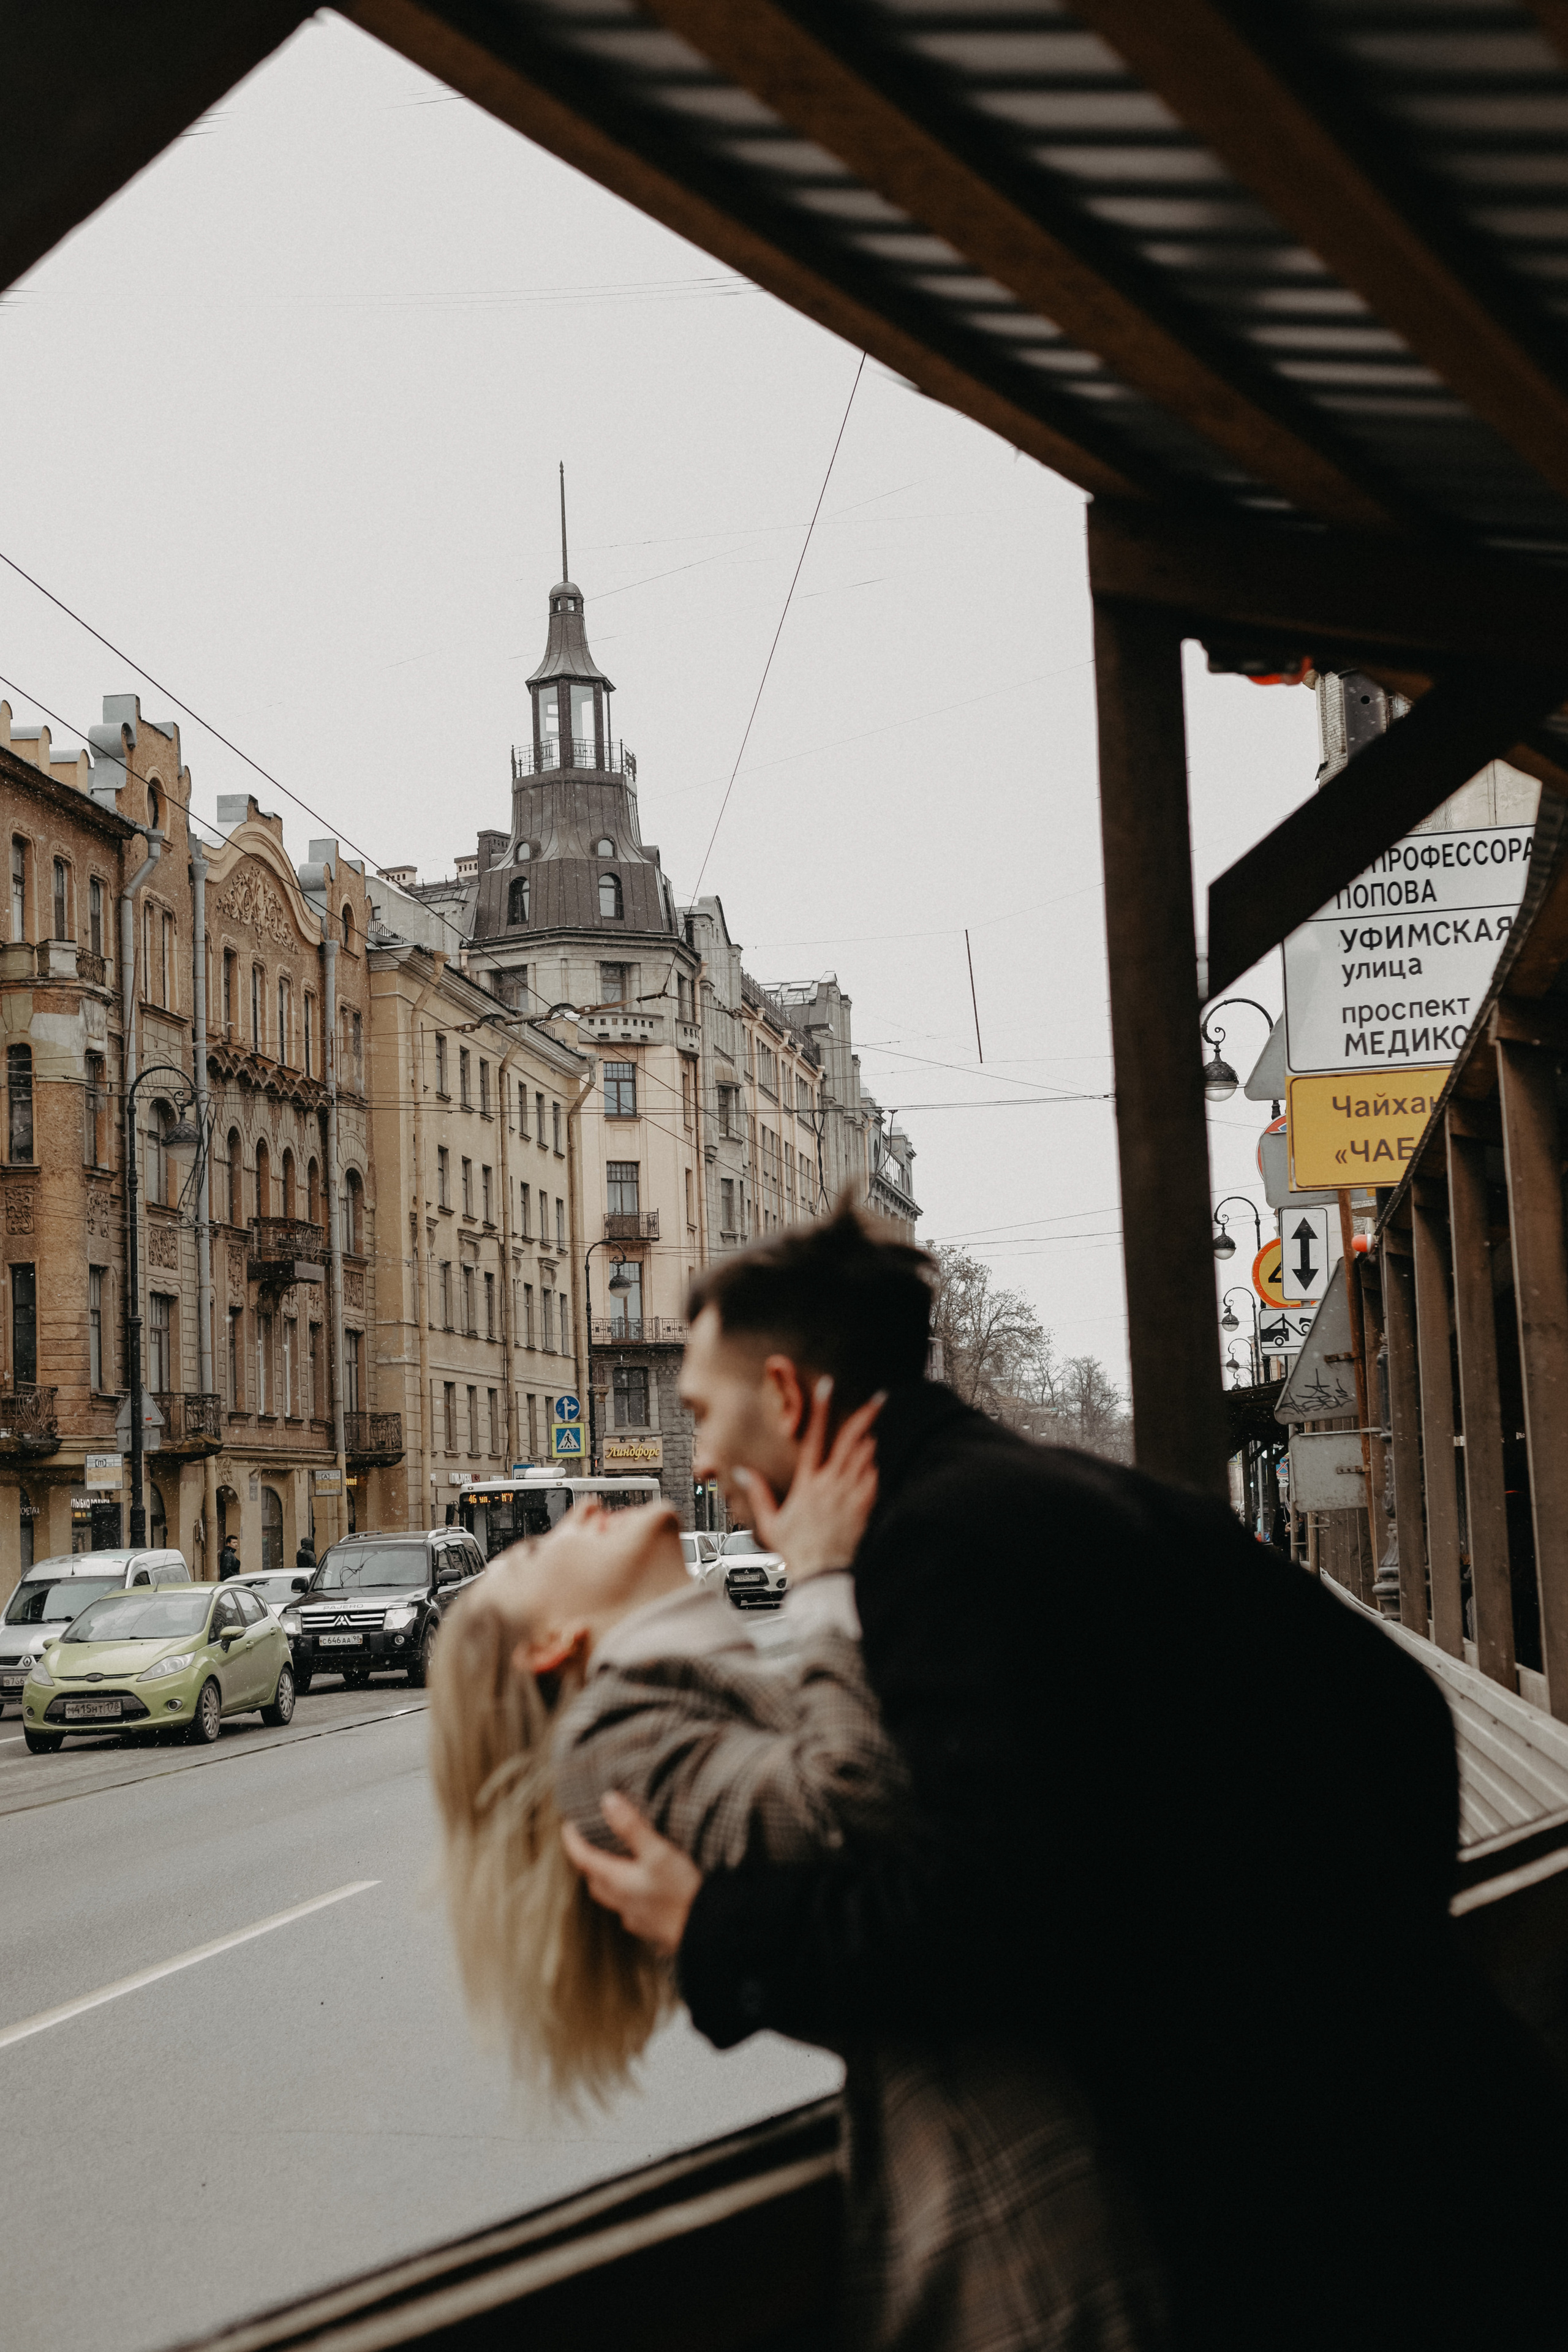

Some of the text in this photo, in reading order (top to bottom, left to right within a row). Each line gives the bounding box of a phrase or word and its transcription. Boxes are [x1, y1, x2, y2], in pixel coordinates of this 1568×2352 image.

[1340, 916, 1513, 954] УФИМСКАЯ
[1341, 957, 1423, 987] улица
[1343, 997, 1471, 1028] проспект
[1345, 1025, 1470, 1058] МЕДИКО
[606, 1444, 660, 1460] Линдфорс
[469, 1494, 477, 1504] 46
